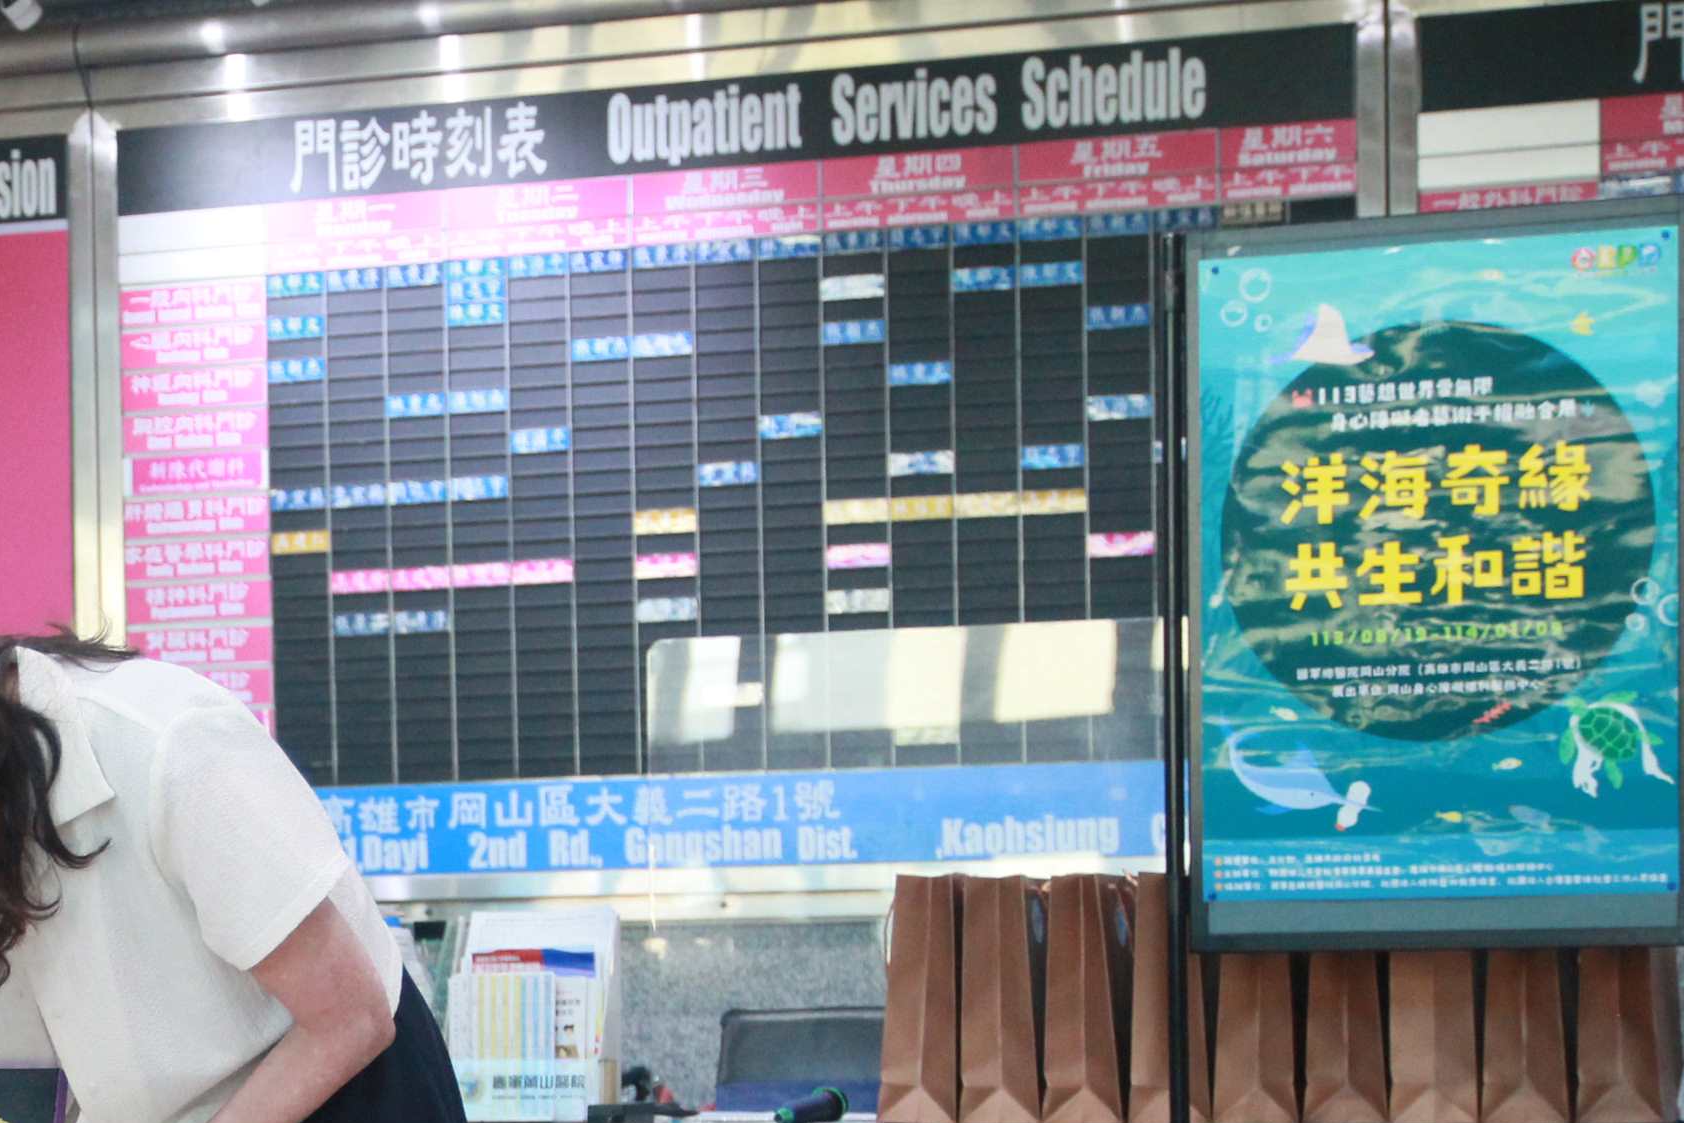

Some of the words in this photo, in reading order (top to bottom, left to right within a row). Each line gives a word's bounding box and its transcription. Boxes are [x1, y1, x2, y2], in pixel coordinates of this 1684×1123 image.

[291, 101, 547, 193] 門診時刻表
[607, 83, 803, 165] Outpatient
[831, 68, 998, 147] Services
[1021, 46, 1207, 130] Schedule
[1238, 124, 1335, 150] 星期六
[874, 154, 962, 178] 星期四
[1070, 136, 1162, 165] 星期五
[1279, 439, 1593, 525] 洋海奇緣
[1284, 529, 1589, 611] 共生和諧
[467, 829, 528, 869] 2nd
[624, 823, 783, 866] Gangshan
[796, 826, 858, 860] Dist.
